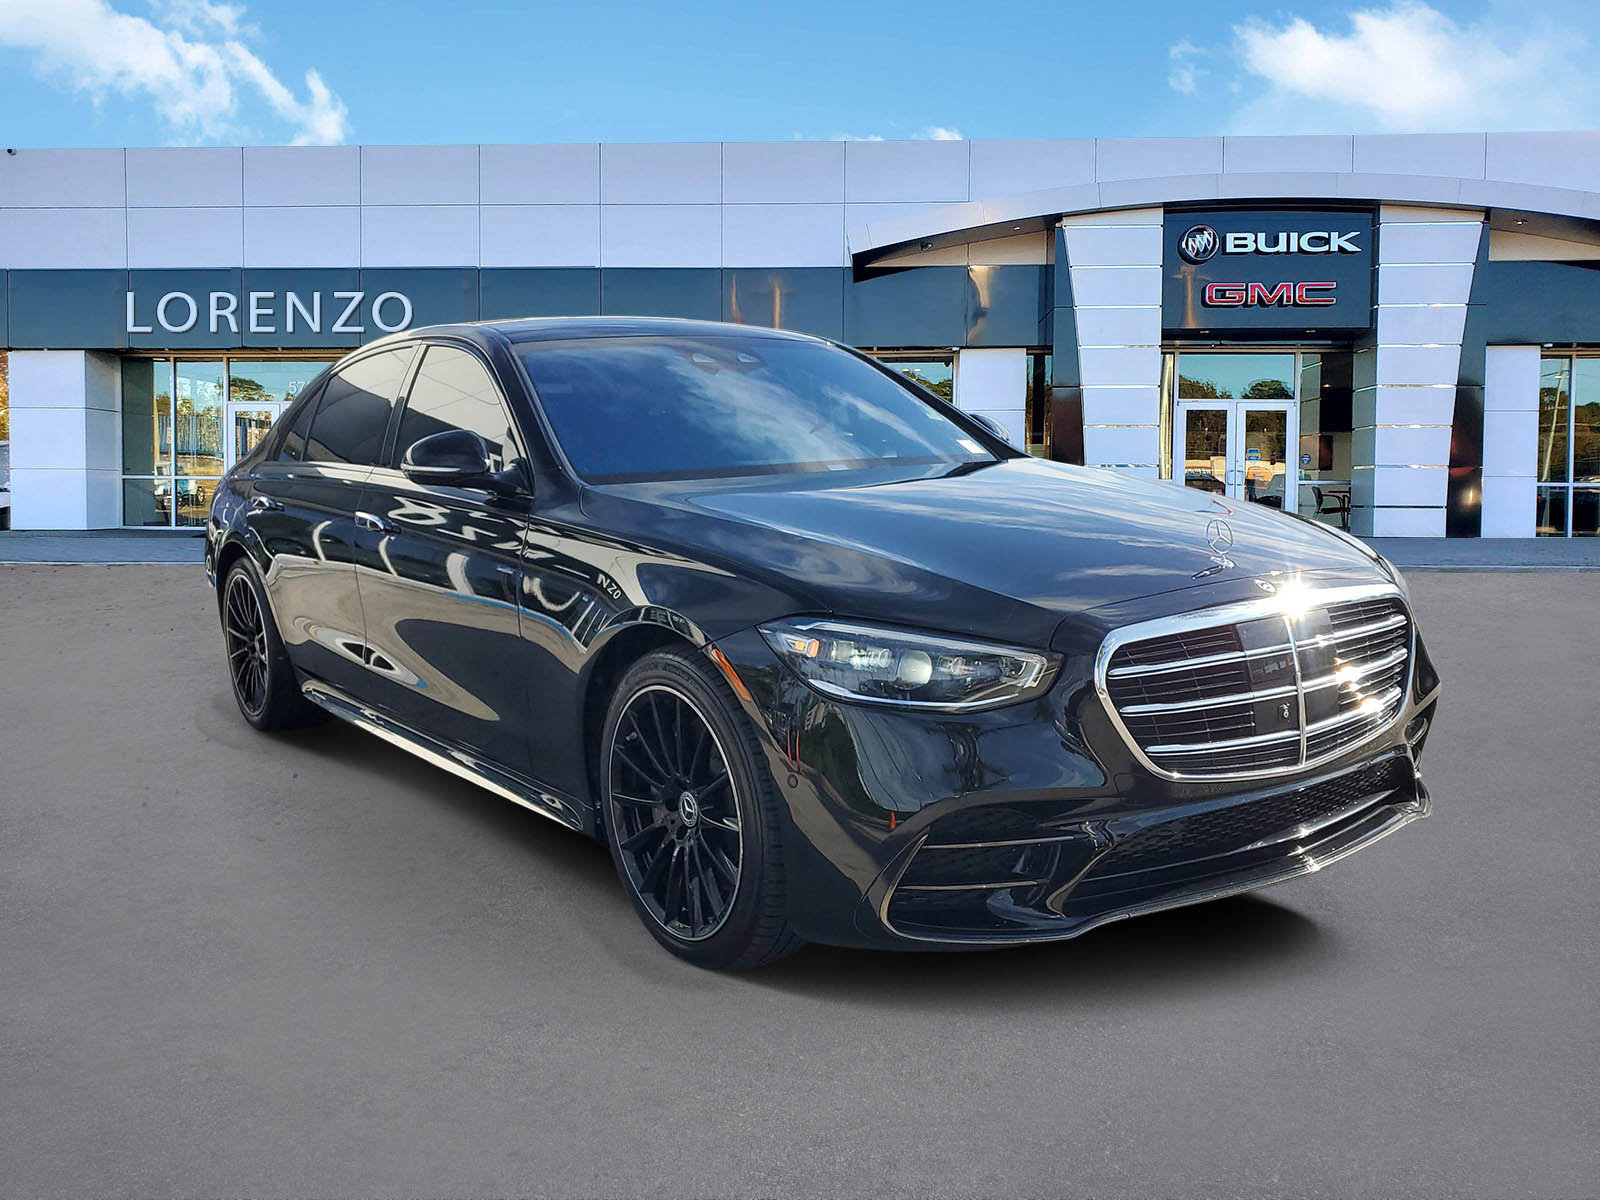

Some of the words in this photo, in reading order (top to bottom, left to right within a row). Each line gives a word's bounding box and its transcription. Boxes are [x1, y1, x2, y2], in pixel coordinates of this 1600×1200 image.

[1225, 231, 1362, 253] BUICK
[1206, 281, 1337, 305] GMC
[126, 291, 414, 334] LORENZO
